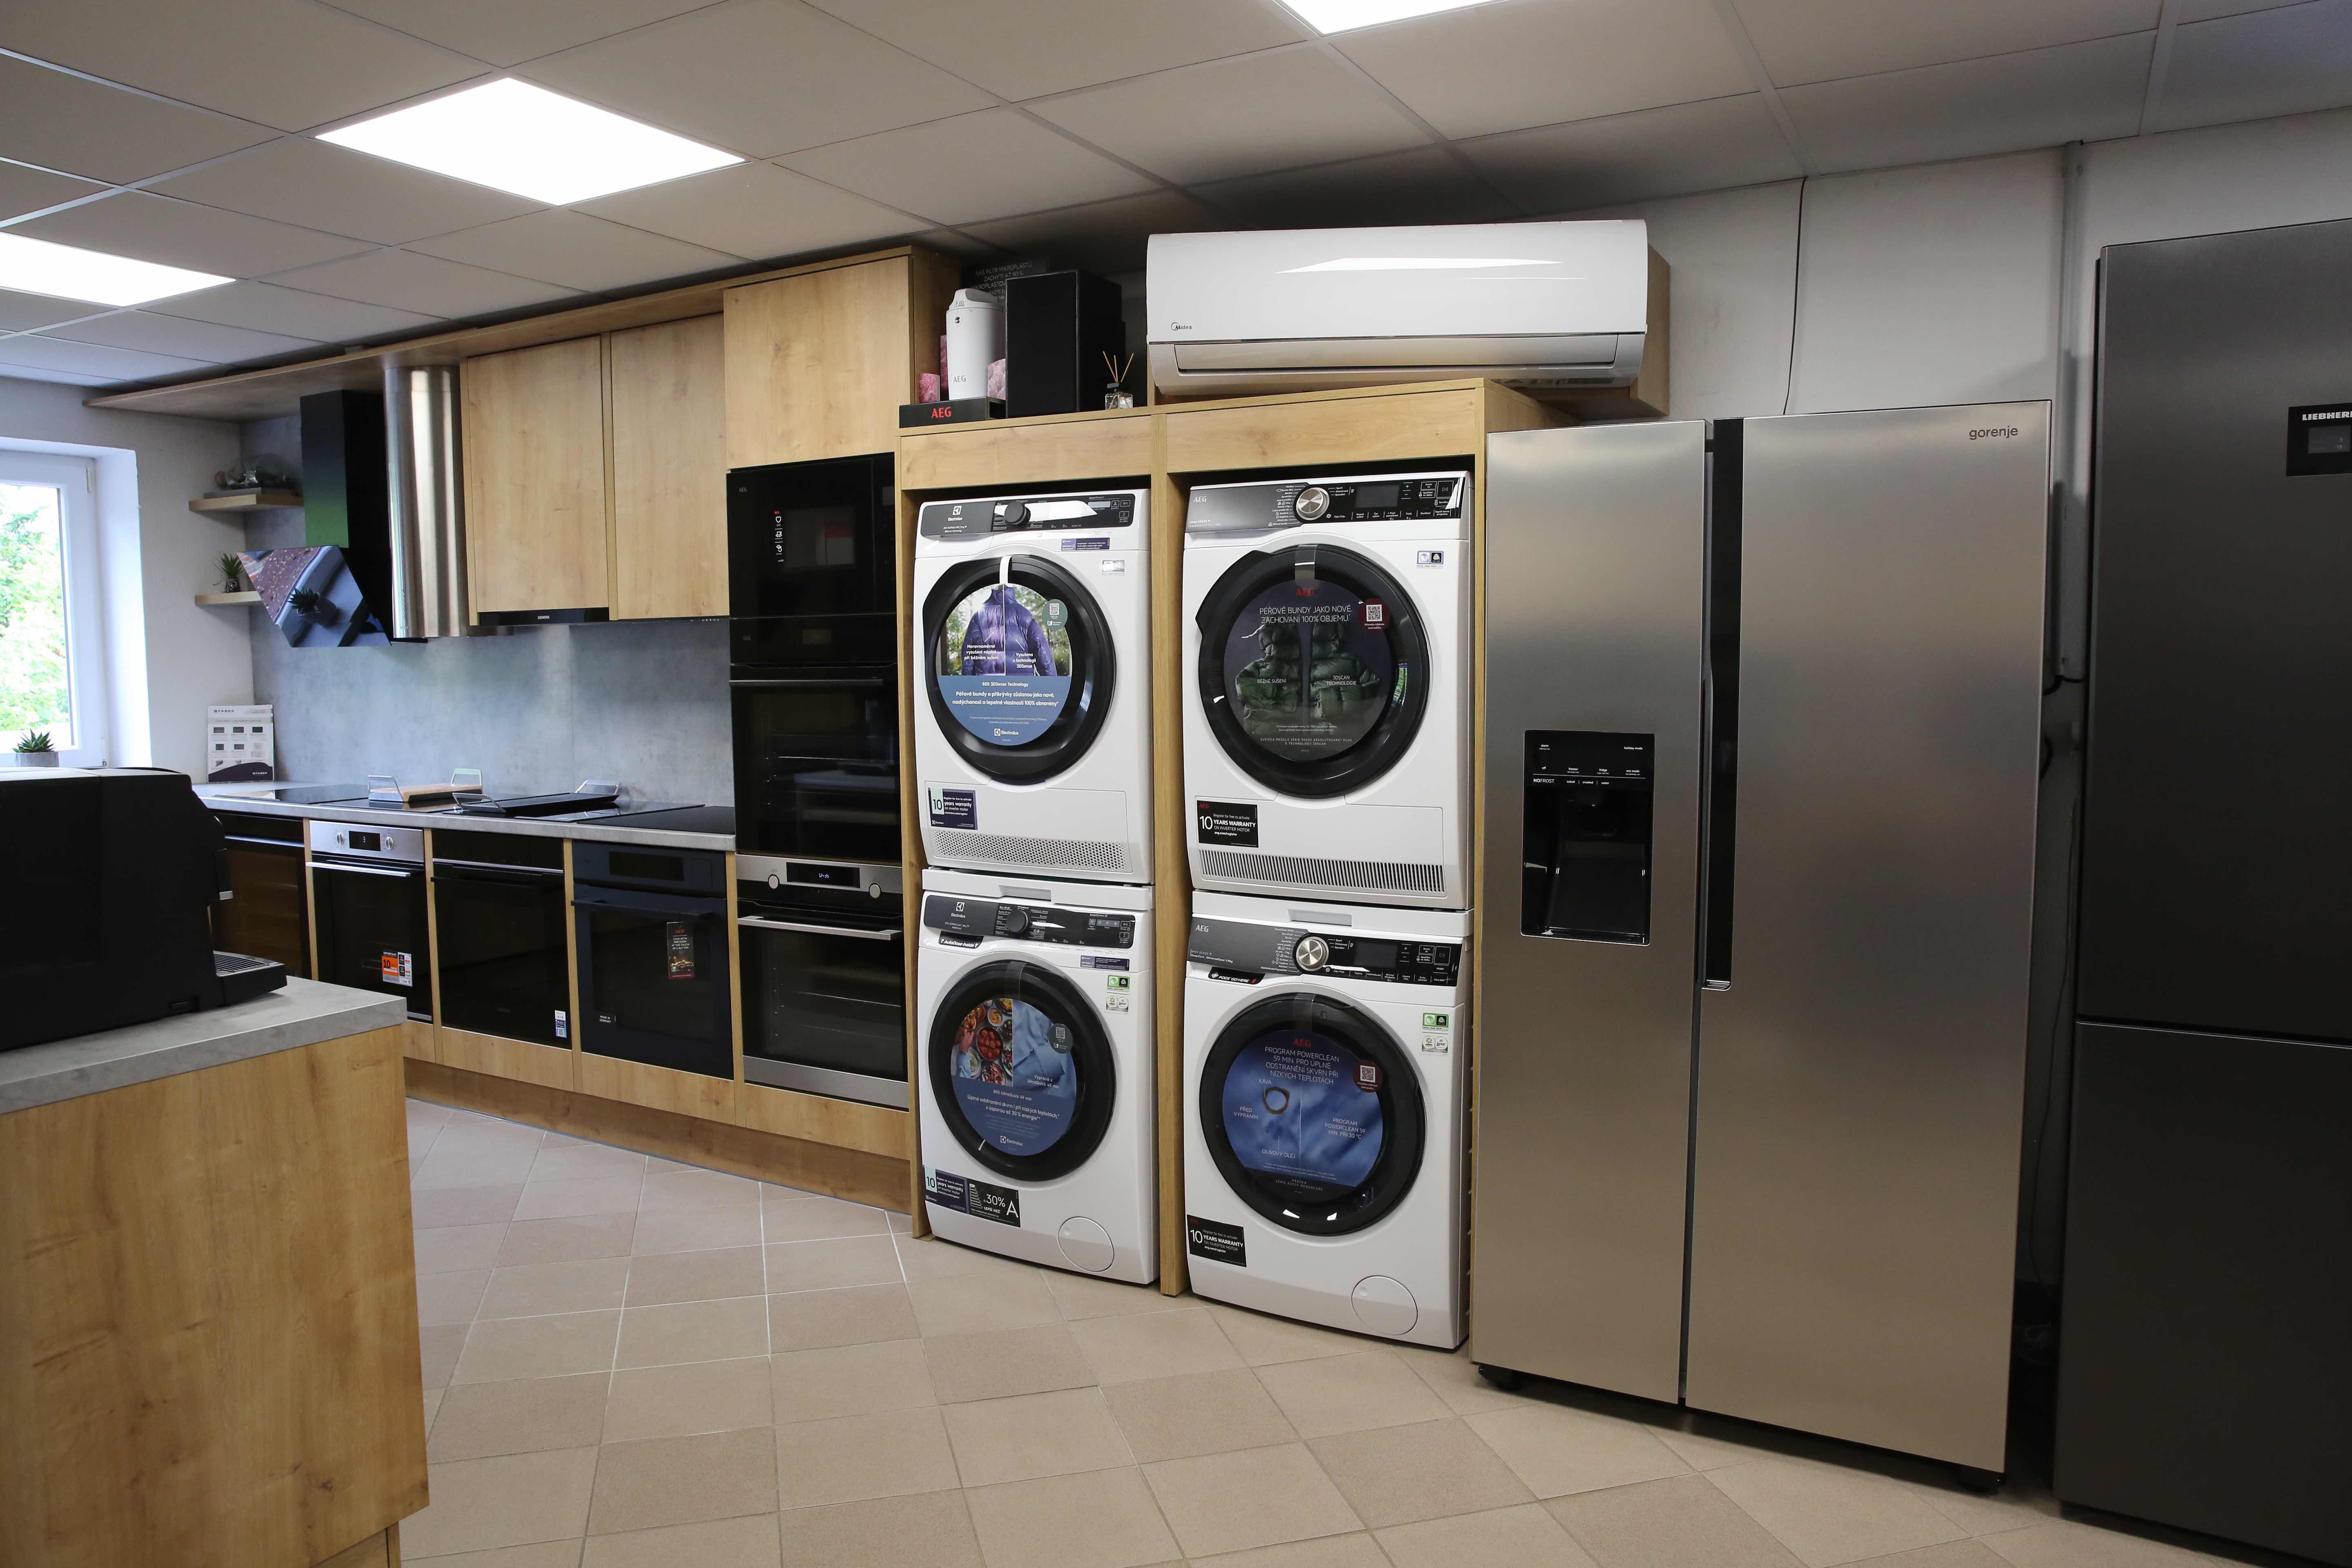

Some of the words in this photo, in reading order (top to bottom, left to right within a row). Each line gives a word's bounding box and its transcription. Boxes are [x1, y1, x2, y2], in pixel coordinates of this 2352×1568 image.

[1171, 322, 1192, 331] Midea
[931, 407, 951, 418] AEG
[2302, 411, 2352, 421] LIEBHER
[1969, 425, 2018, 440] gorenje
[1259, 606, 1286, 615] PÉŘOVÉ
[1332, 604, 1352, 612] NOVÉ.
[1261, 615, 1300, 624] ZACHOVÁNÍ
[933, 799, 942, 810] 10
[1199, 815, 1213, 830] 10
[1195, 924, 1209, 933] AEG
[1294, 1038, 1311, 1047] AEG
[1265, 1046, 1295, 1056] PROGRAM
[1297, 1051, 1339, 1062] POWERCLEAN
[1266, 1062, 1305, 1073] ODSTRANĚNÍ
[1306, 1068, 1327, 1076] SKVRN
[1310, 1060, 1331, 1069] ÚPLNÉ
[1298, 1074, 1334, 1085] TEPLOTÁCH
[980, 1097, 1001, 1106] odstranění
[1325, 1123, 1359, 1132] POWERCLEAN
[927, 1176, 935, 1188] 10
[947, 1184, 964, 1193] warranty
[986, 1194, 1006, 1207] 30%
[1006, 1200, 1019, 1218] A
[1190, 1229, 1203, 1243] 10
[1218, 1238, 1243, 1247] WARRANTY
